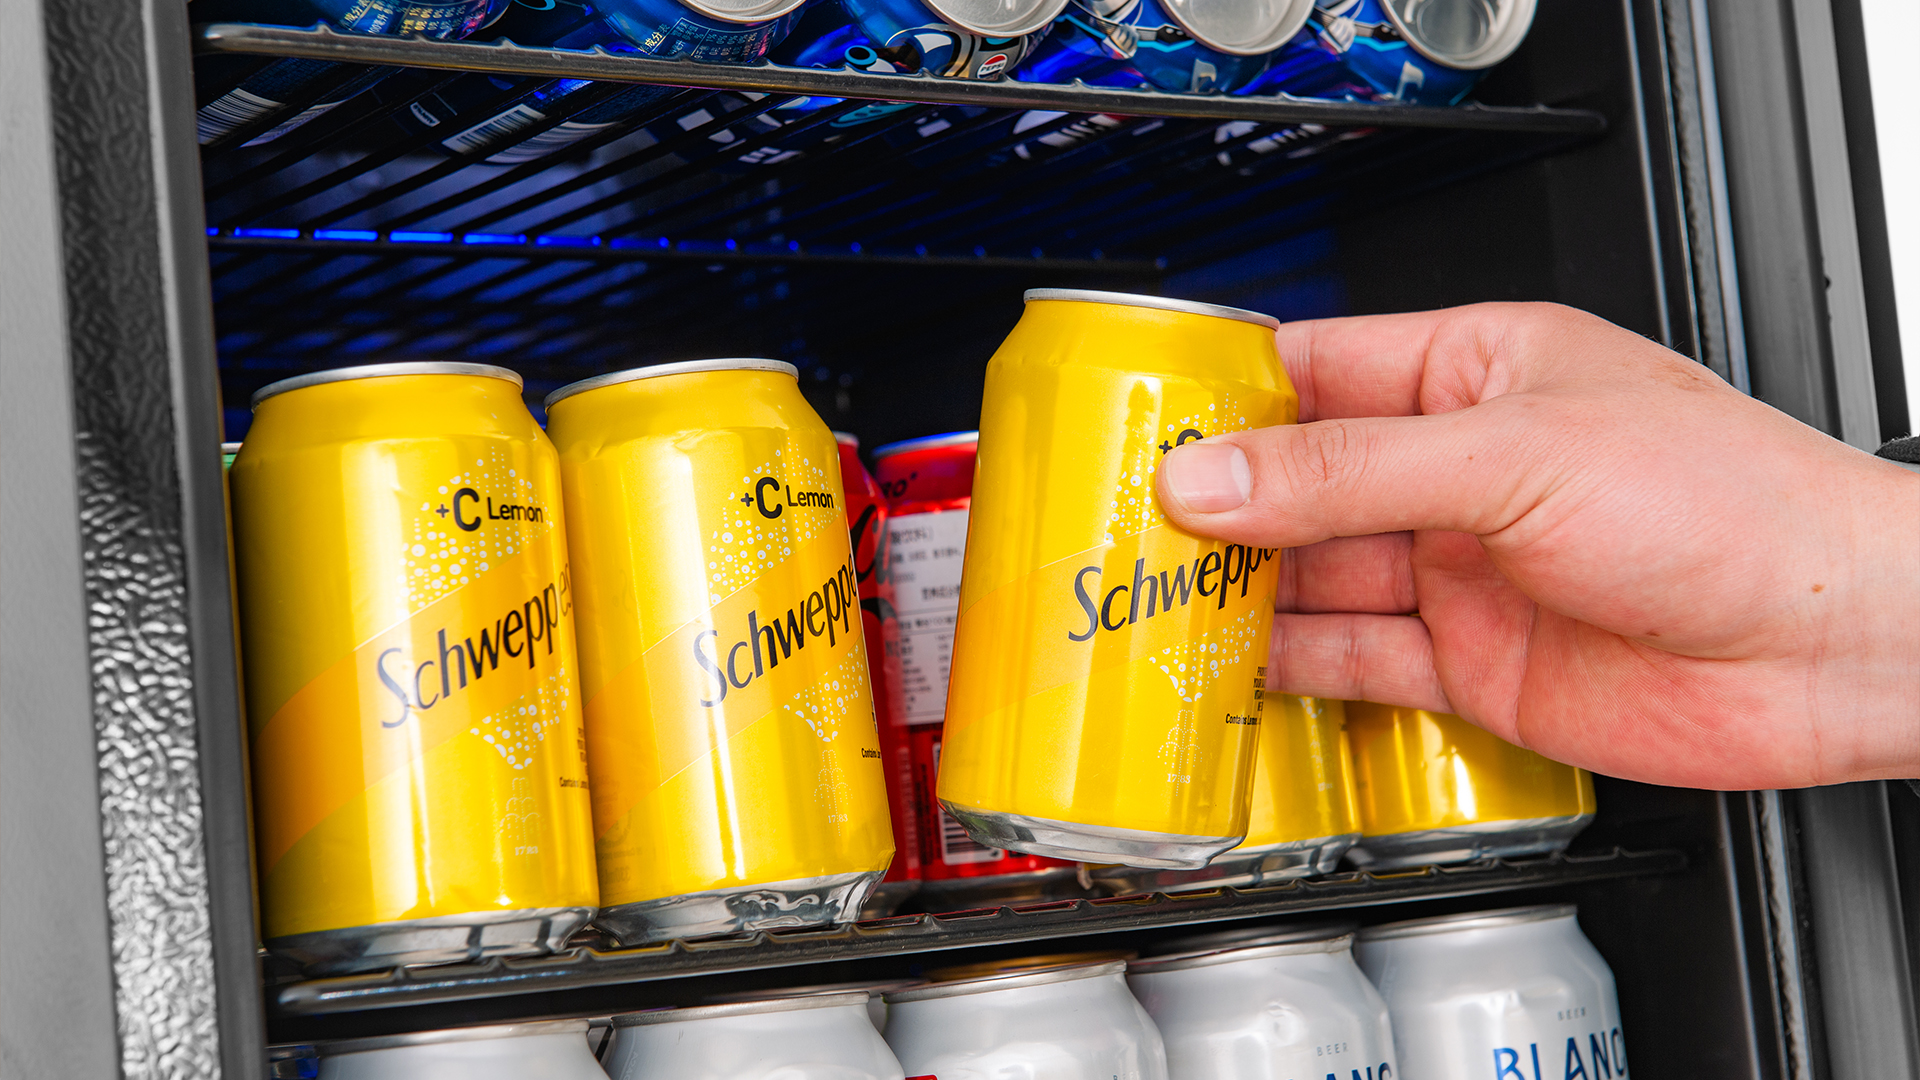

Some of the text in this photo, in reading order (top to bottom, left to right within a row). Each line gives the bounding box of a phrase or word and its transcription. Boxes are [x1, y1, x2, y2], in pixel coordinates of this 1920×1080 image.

[980, 62, 1005, 72] PEPSI
[435, 487, 544, 532] +C Lemon
[740, 476, 835, 519] +C Lemon
[1068, 543, 1279, 642] Schwepp
[1316, 1042, 1349, 1057] BEER
